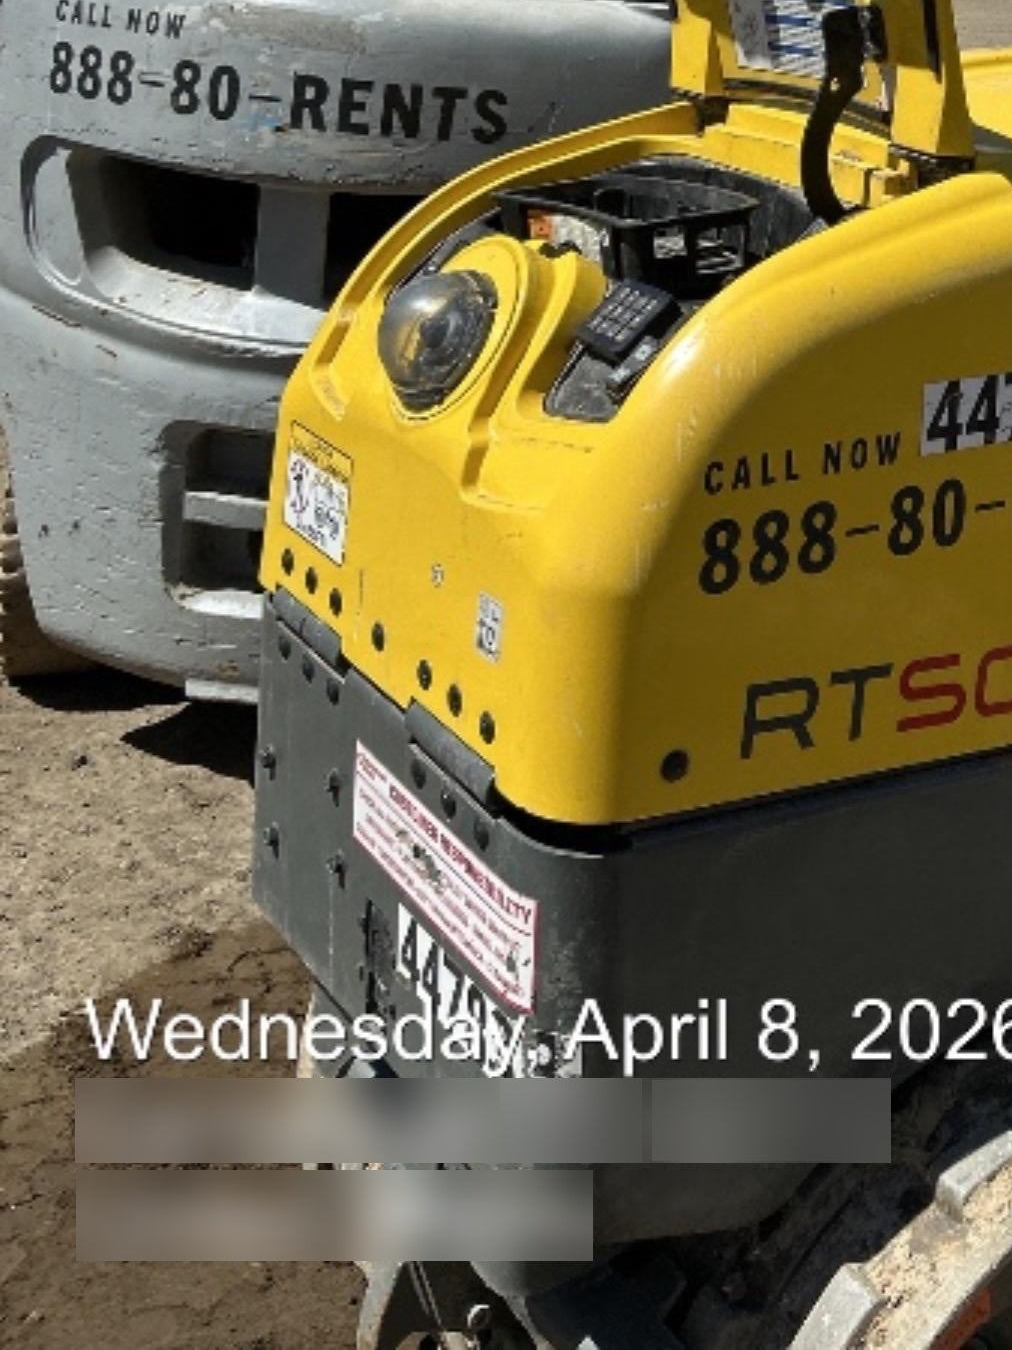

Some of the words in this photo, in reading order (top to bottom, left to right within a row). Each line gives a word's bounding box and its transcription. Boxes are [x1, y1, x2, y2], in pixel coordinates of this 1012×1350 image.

[126, 7, 187, 39] NOW
[49, 41, 509, 144] 888-80-RENTS
[704, 449, 800, 495] CALL
[821, 432, 901, 474] NOW
